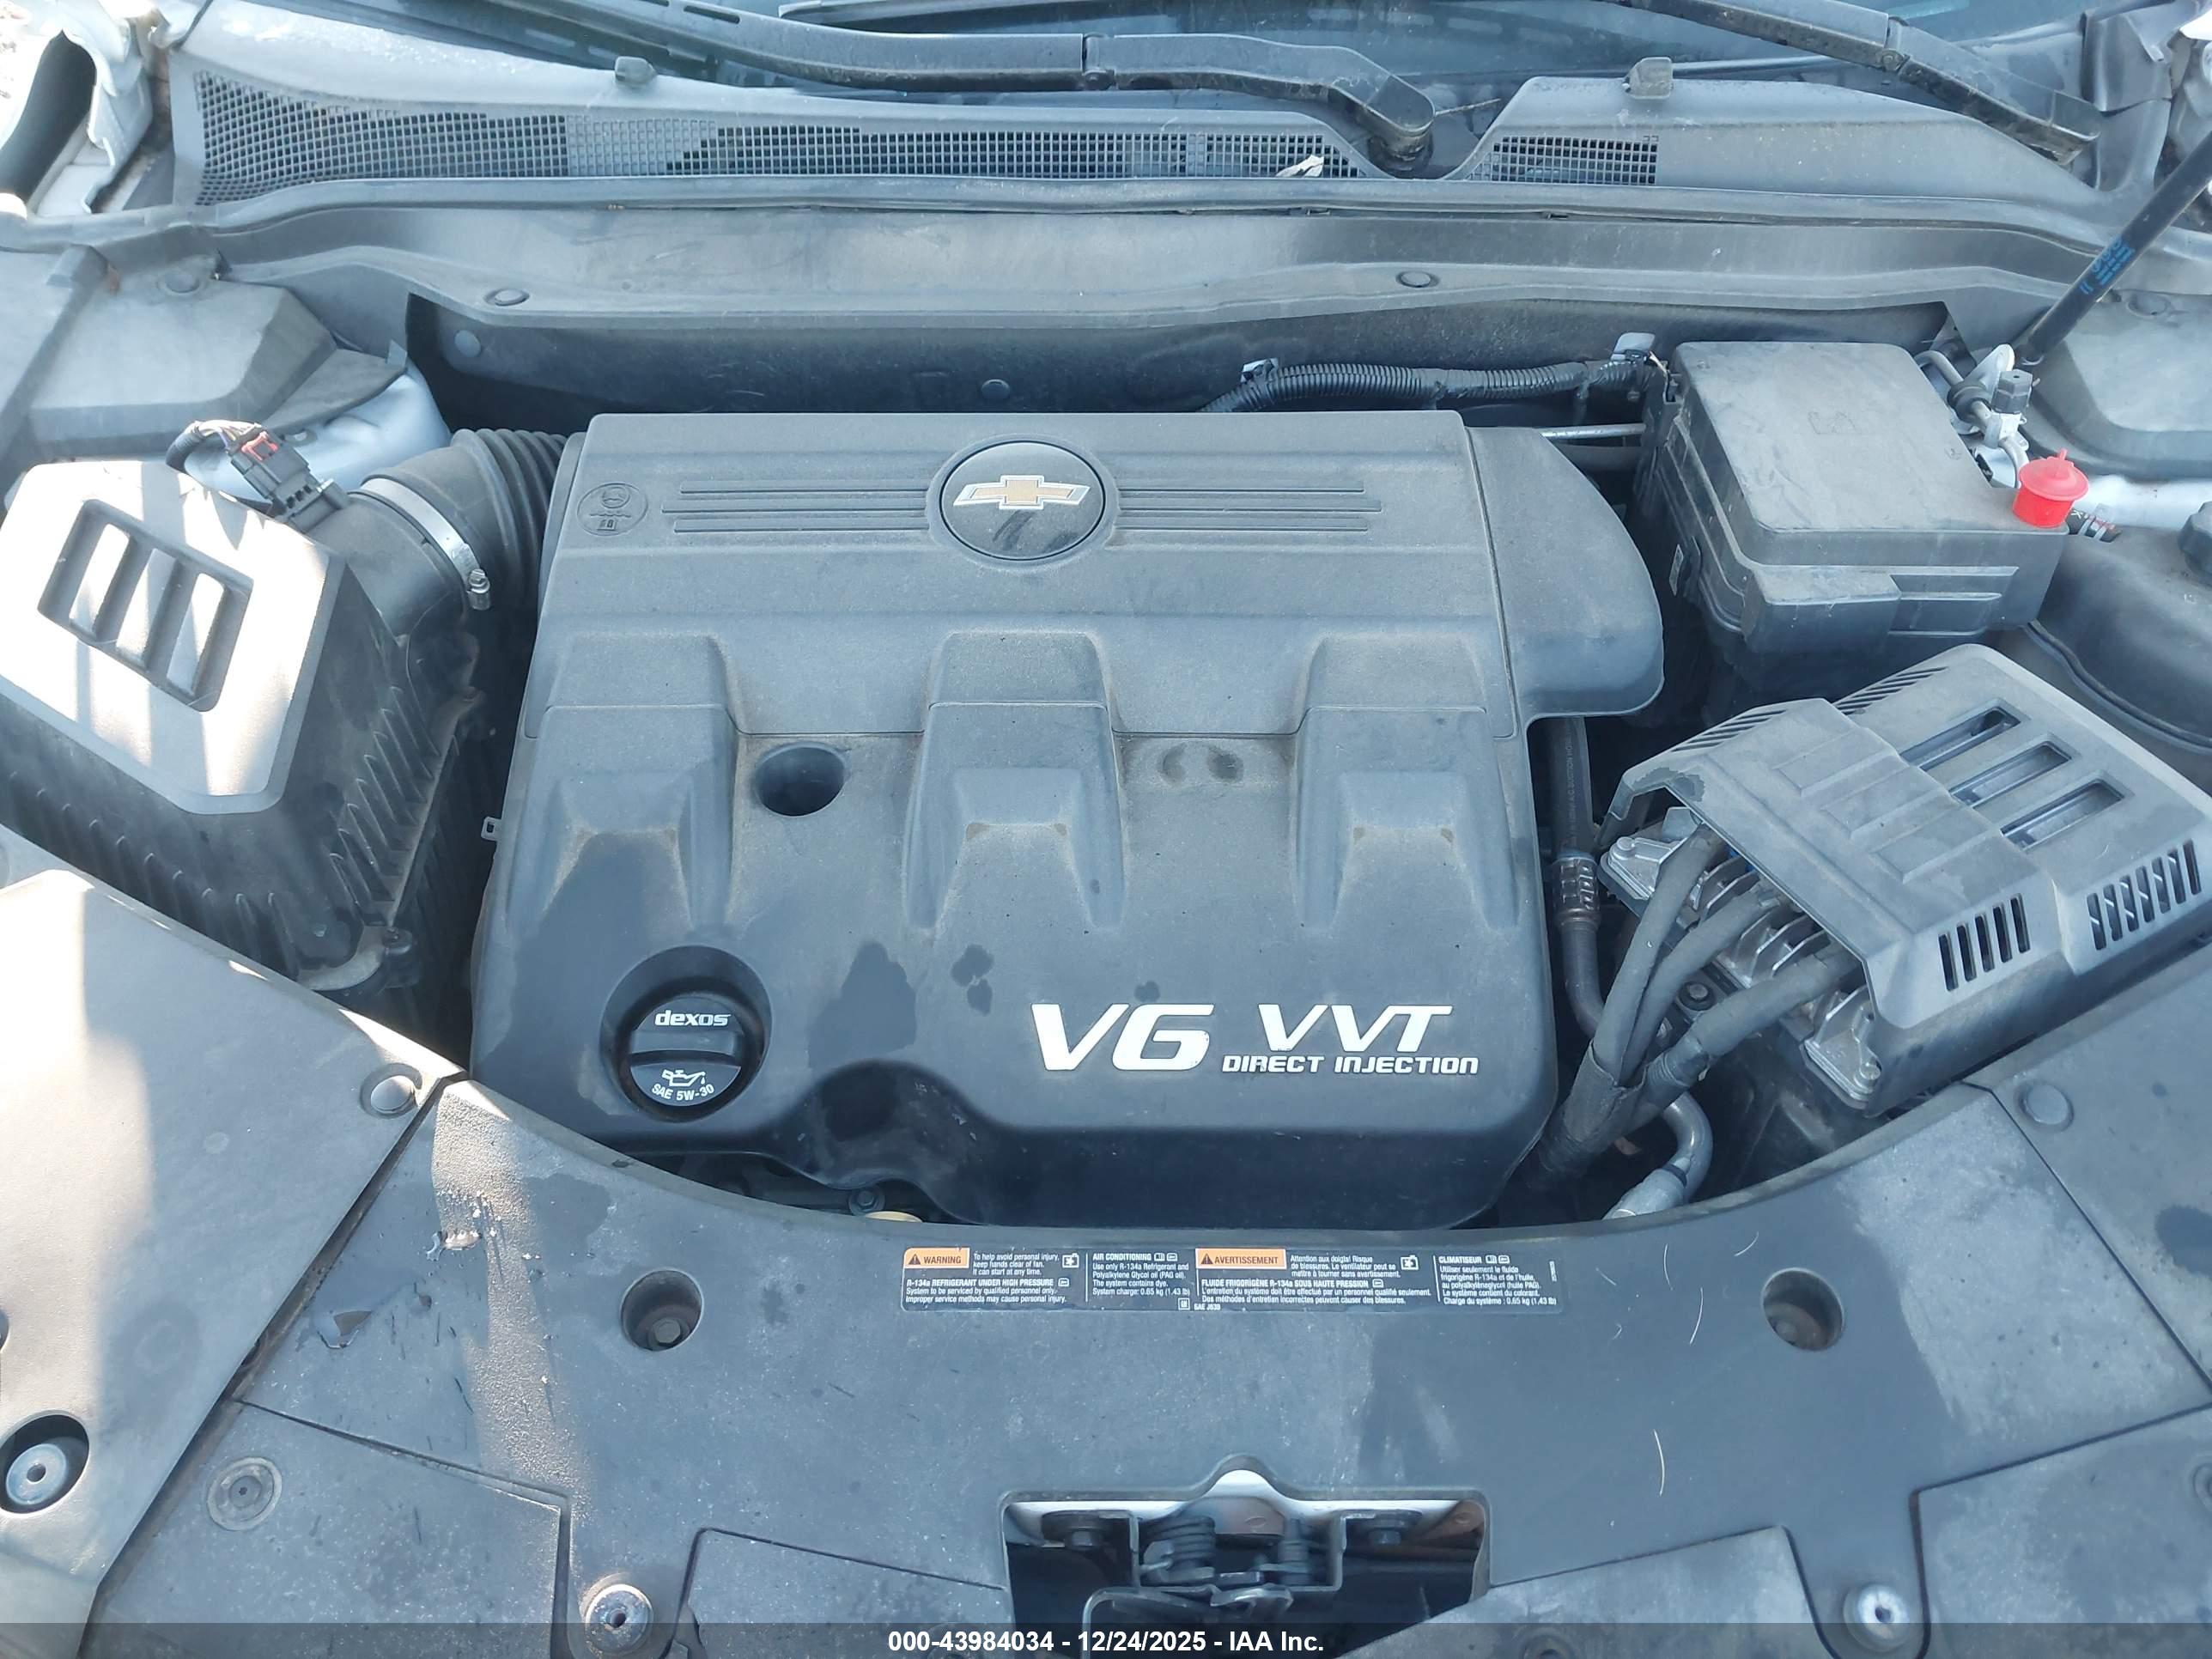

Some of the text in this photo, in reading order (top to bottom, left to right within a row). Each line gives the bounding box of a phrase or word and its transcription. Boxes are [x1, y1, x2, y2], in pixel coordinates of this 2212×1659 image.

[654, 1010, 731, 1026] dexos
[1031, 1004, 1453, 1071] V6 VVT
[1222, 1055, 1479, 1074] DIRECT INJECTION
[652, 1084, 714, 1100] SAE 5W-30
